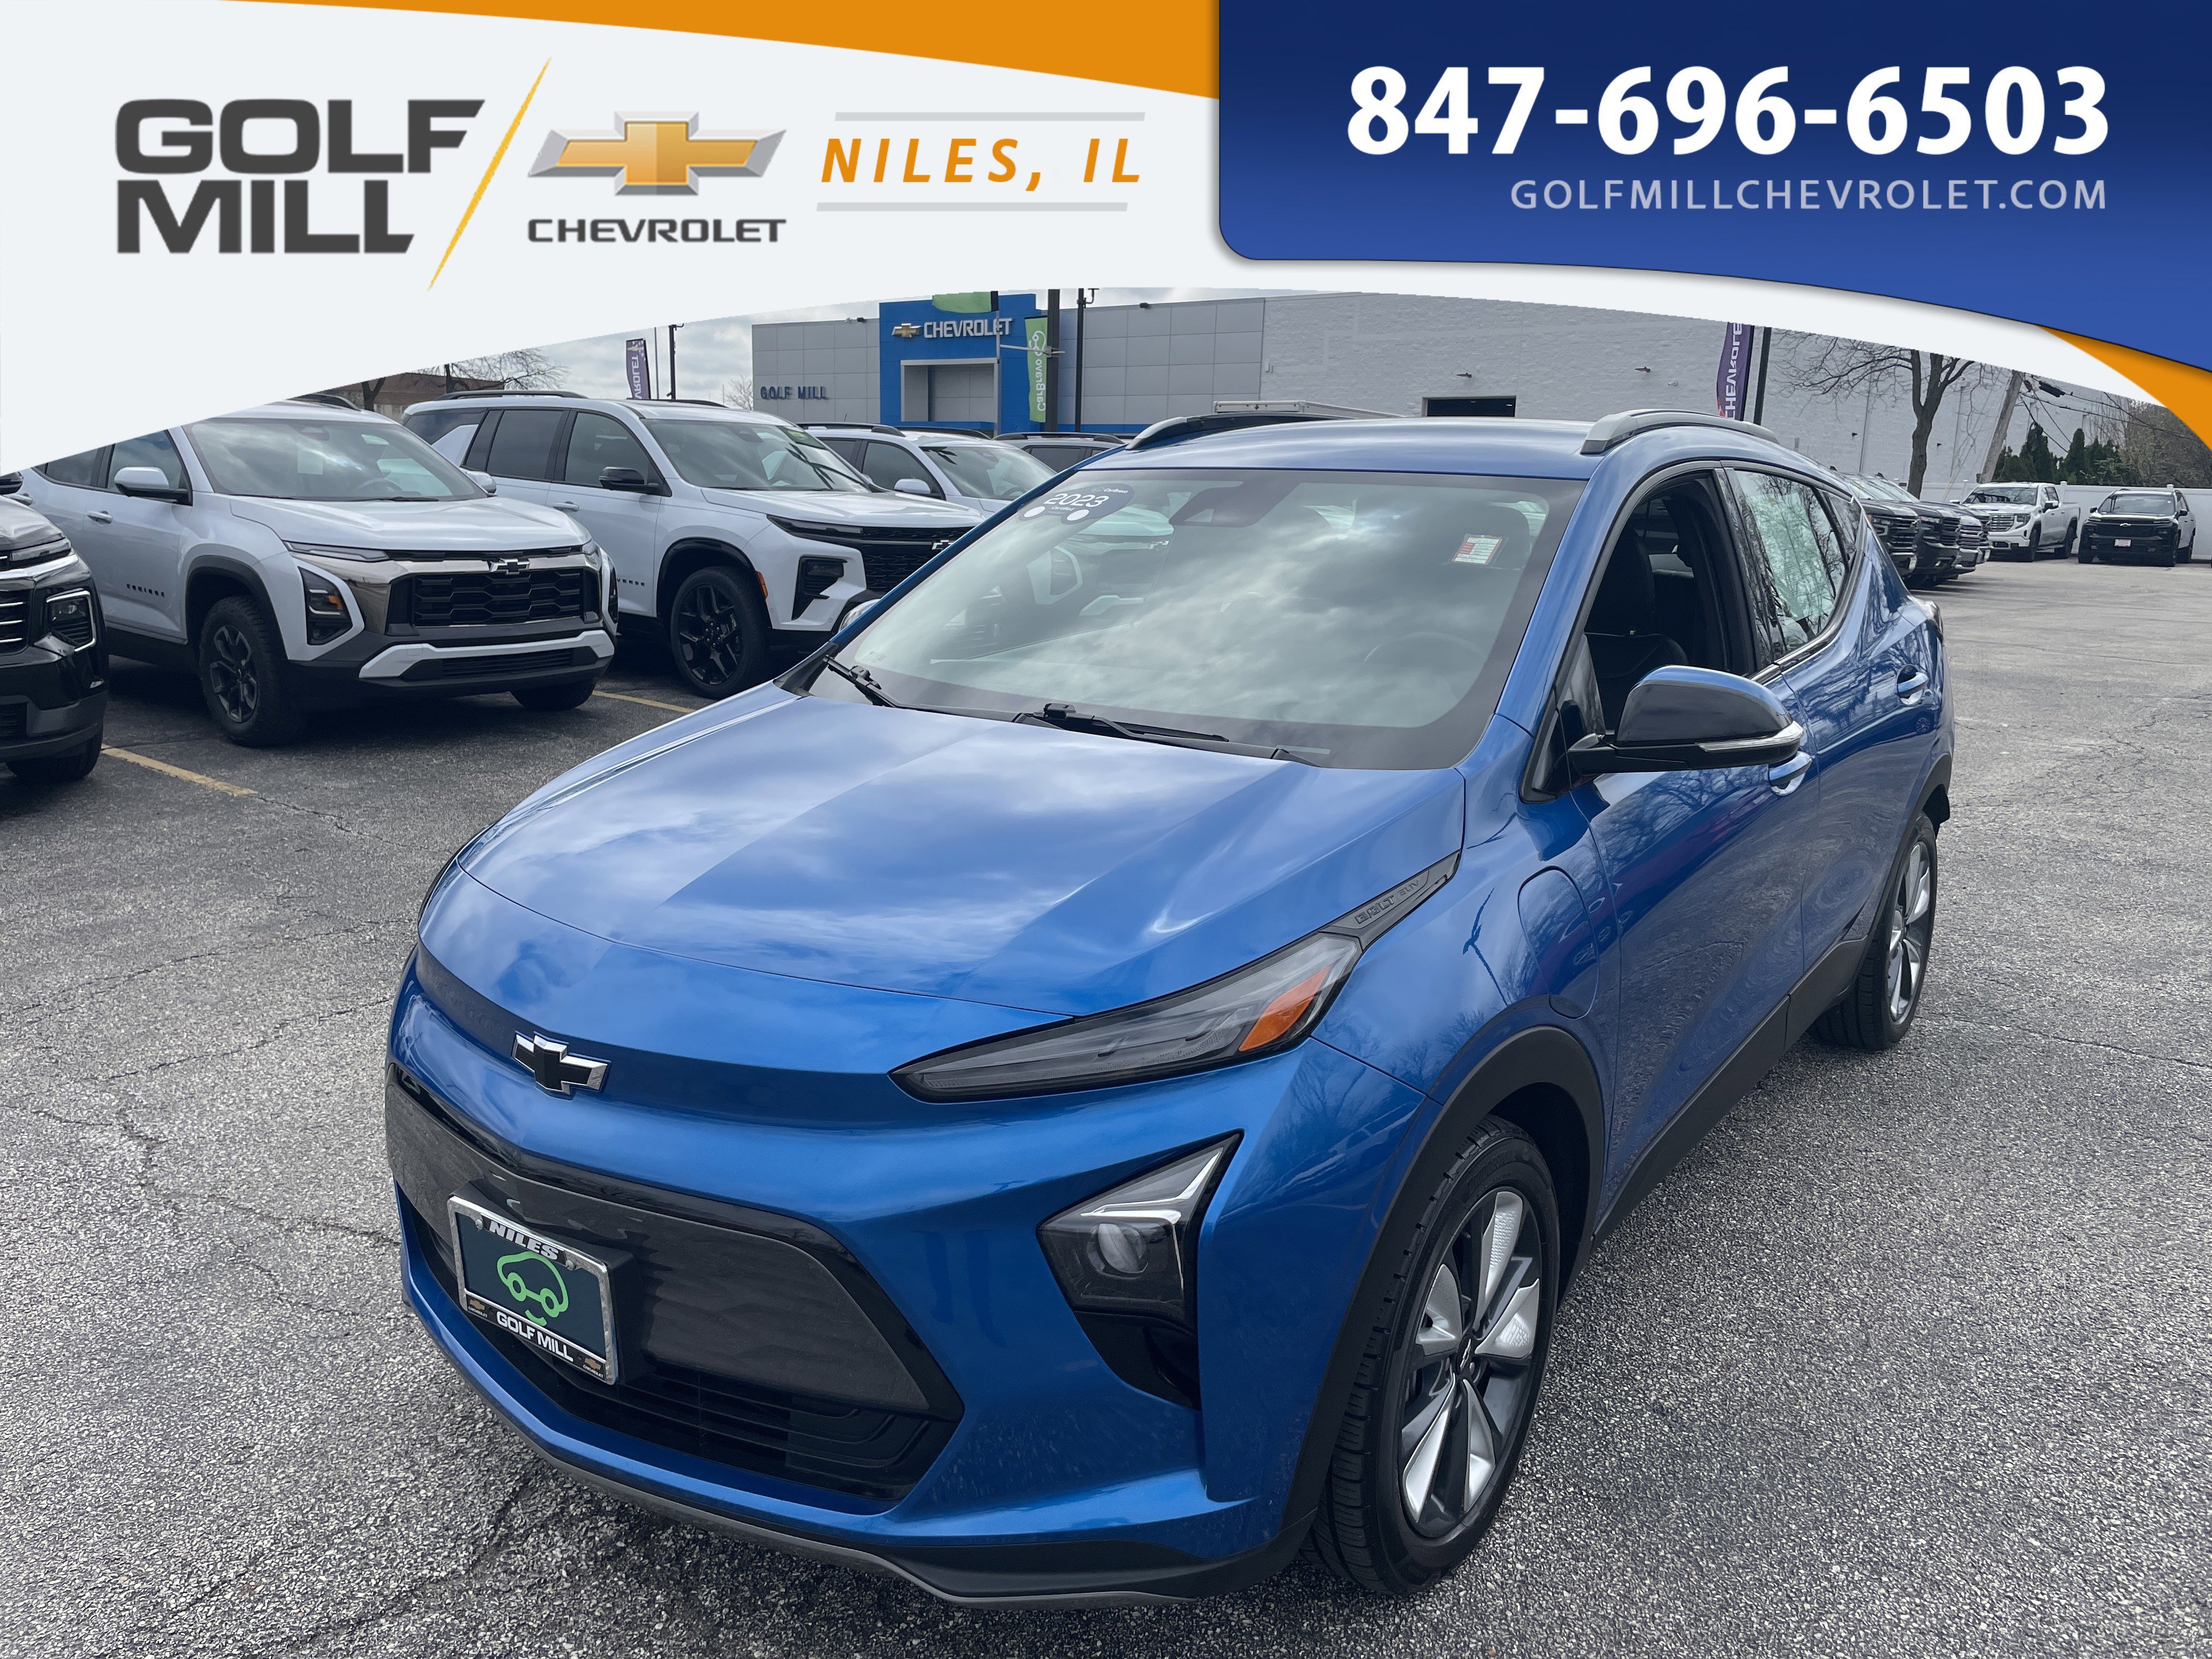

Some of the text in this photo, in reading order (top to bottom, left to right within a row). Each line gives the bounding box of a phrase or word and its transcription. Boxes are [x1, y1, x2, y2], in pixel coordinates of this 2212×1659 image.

[924, 318, 1012, 338] CHEVROLET
[760, 386, 827, 400] GOLF MILL
[1043, 493, 1109, 507] 2023
[489, 1220, 559, 1260] NILES
[496, 1311, 574, 1362] GOLF MILL
